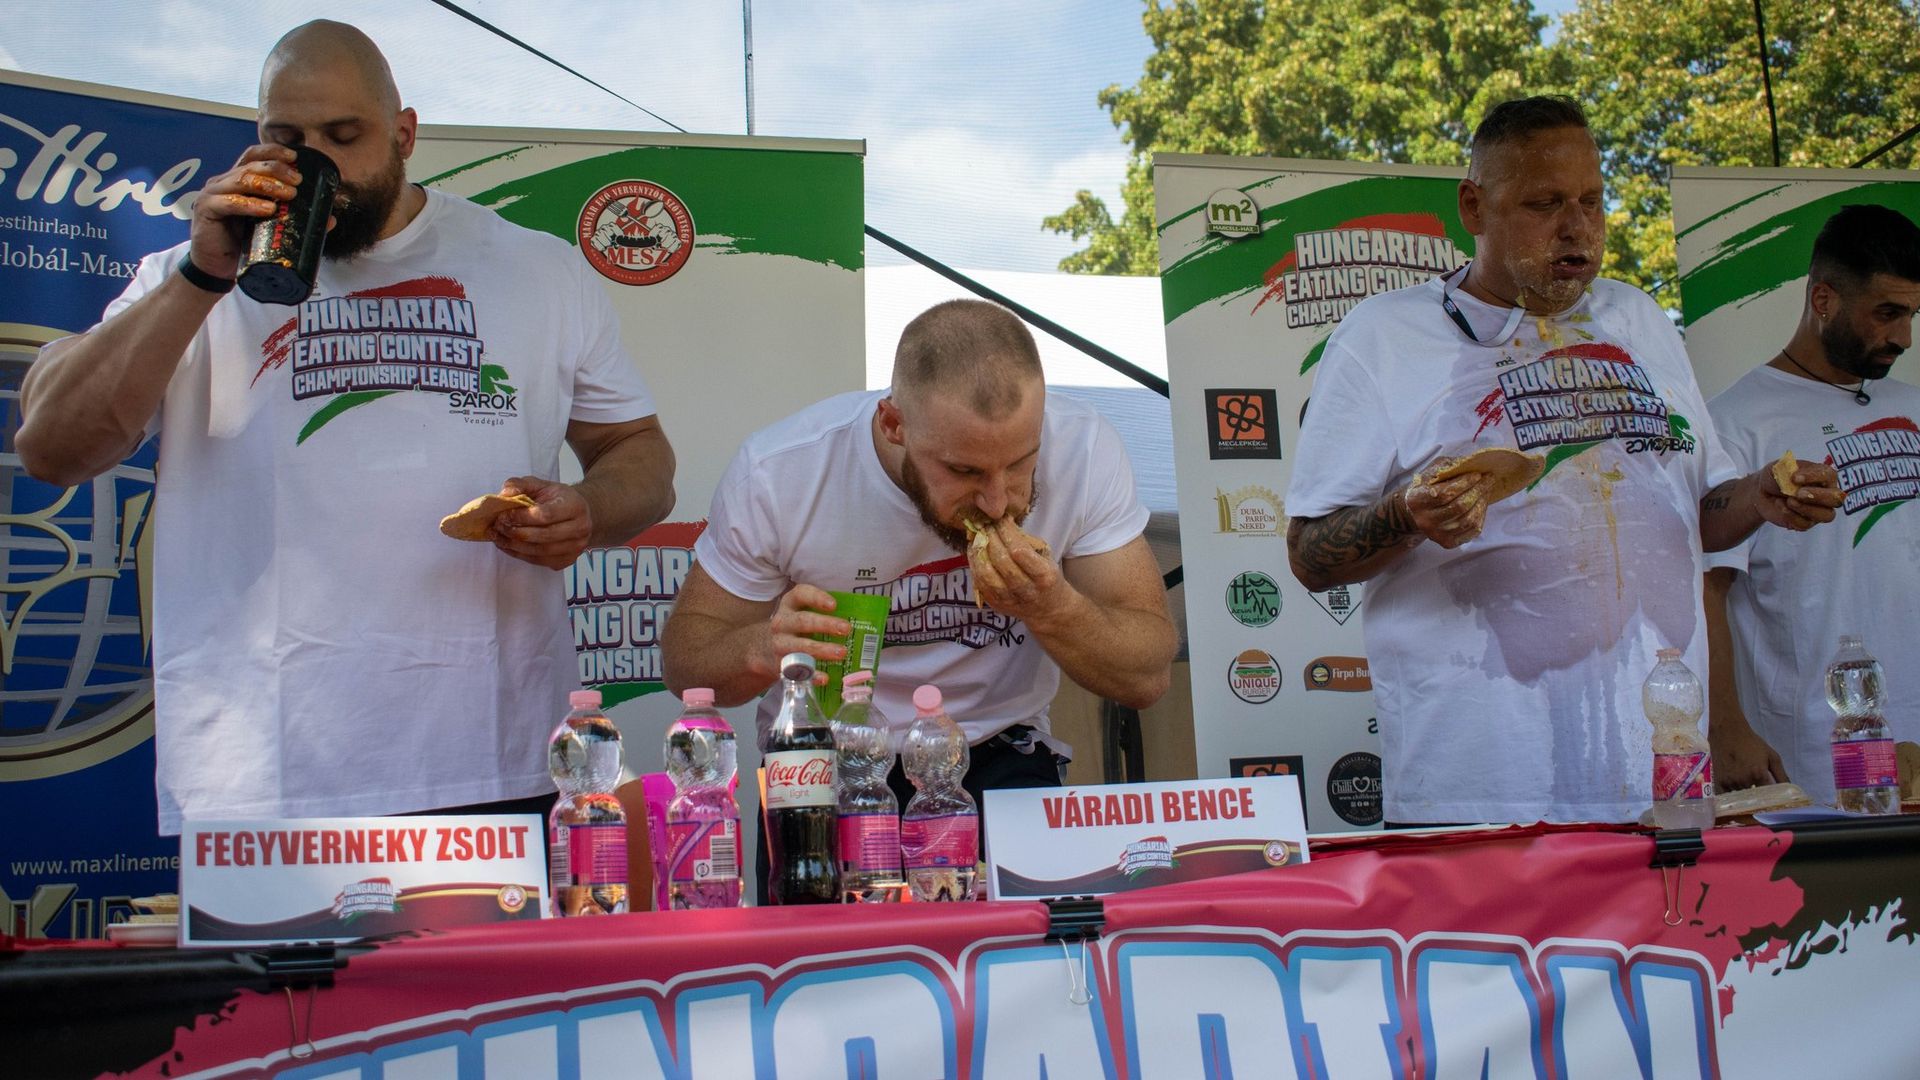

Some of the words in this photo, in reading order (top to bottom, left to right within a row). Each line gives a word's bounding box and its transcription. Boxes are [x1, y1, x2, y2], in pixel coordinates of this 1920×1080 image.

[0, 241, 143, 279] lobál-Max
[606, 247, 669, 266] MESZ
[1298, 229, 1455, 271] HUNGARIAN
[1285, 268, 1366, 301] EATING
[1370, 267, 1438, 293] CONT
[299, 296, 476, 337] HUNGARIAN
[1287, 298, 1359, 328] CHAPIO
[294, 334, 377, 369] EATING
[378, 334, 482, 370] CONTEST
[293, 365, 417, 395] CHAMPIONSHIP
[420, 366, 479, 392] LEAGUE
[1500, 357, 1656, 397] HUNGARIAN
[448, 391, 518, 411] SAROK
[1505, 394, 1576, 422] EATING
[1577, 391, 1668, 417] CONTEST
[1515, 416, 1615, 448] CHAMPIONSHIP
[1616, 414, 1671, 438] LEAGUE
[1828, 430, 1920, 468] HUNGARIA
[1838, 461, 1885, 490] EATING
[1240, 508, 1264, 516] DUBAI
[1845, 480, 1917, 513] CHAMPIONSHIP
[1239, 522, 1266, 530] NEKED
[1245, 514, 1276, 523] PARFÜM
[1233, 677, 1278, 689] UNIQUE
[1332, 668, 1354, 681] Firpo
[1242, 688, 1271, 696] BURGER
[767, 757, 833, 788] Coca-Cola
[1042, 790, 1155, 829] VÁRADI
[1161, 787, 1256, 824] BENCE
[196, 826, 428, 868] FEGYVERNEKY
[436, 825, 530, 862] ZSOLT
